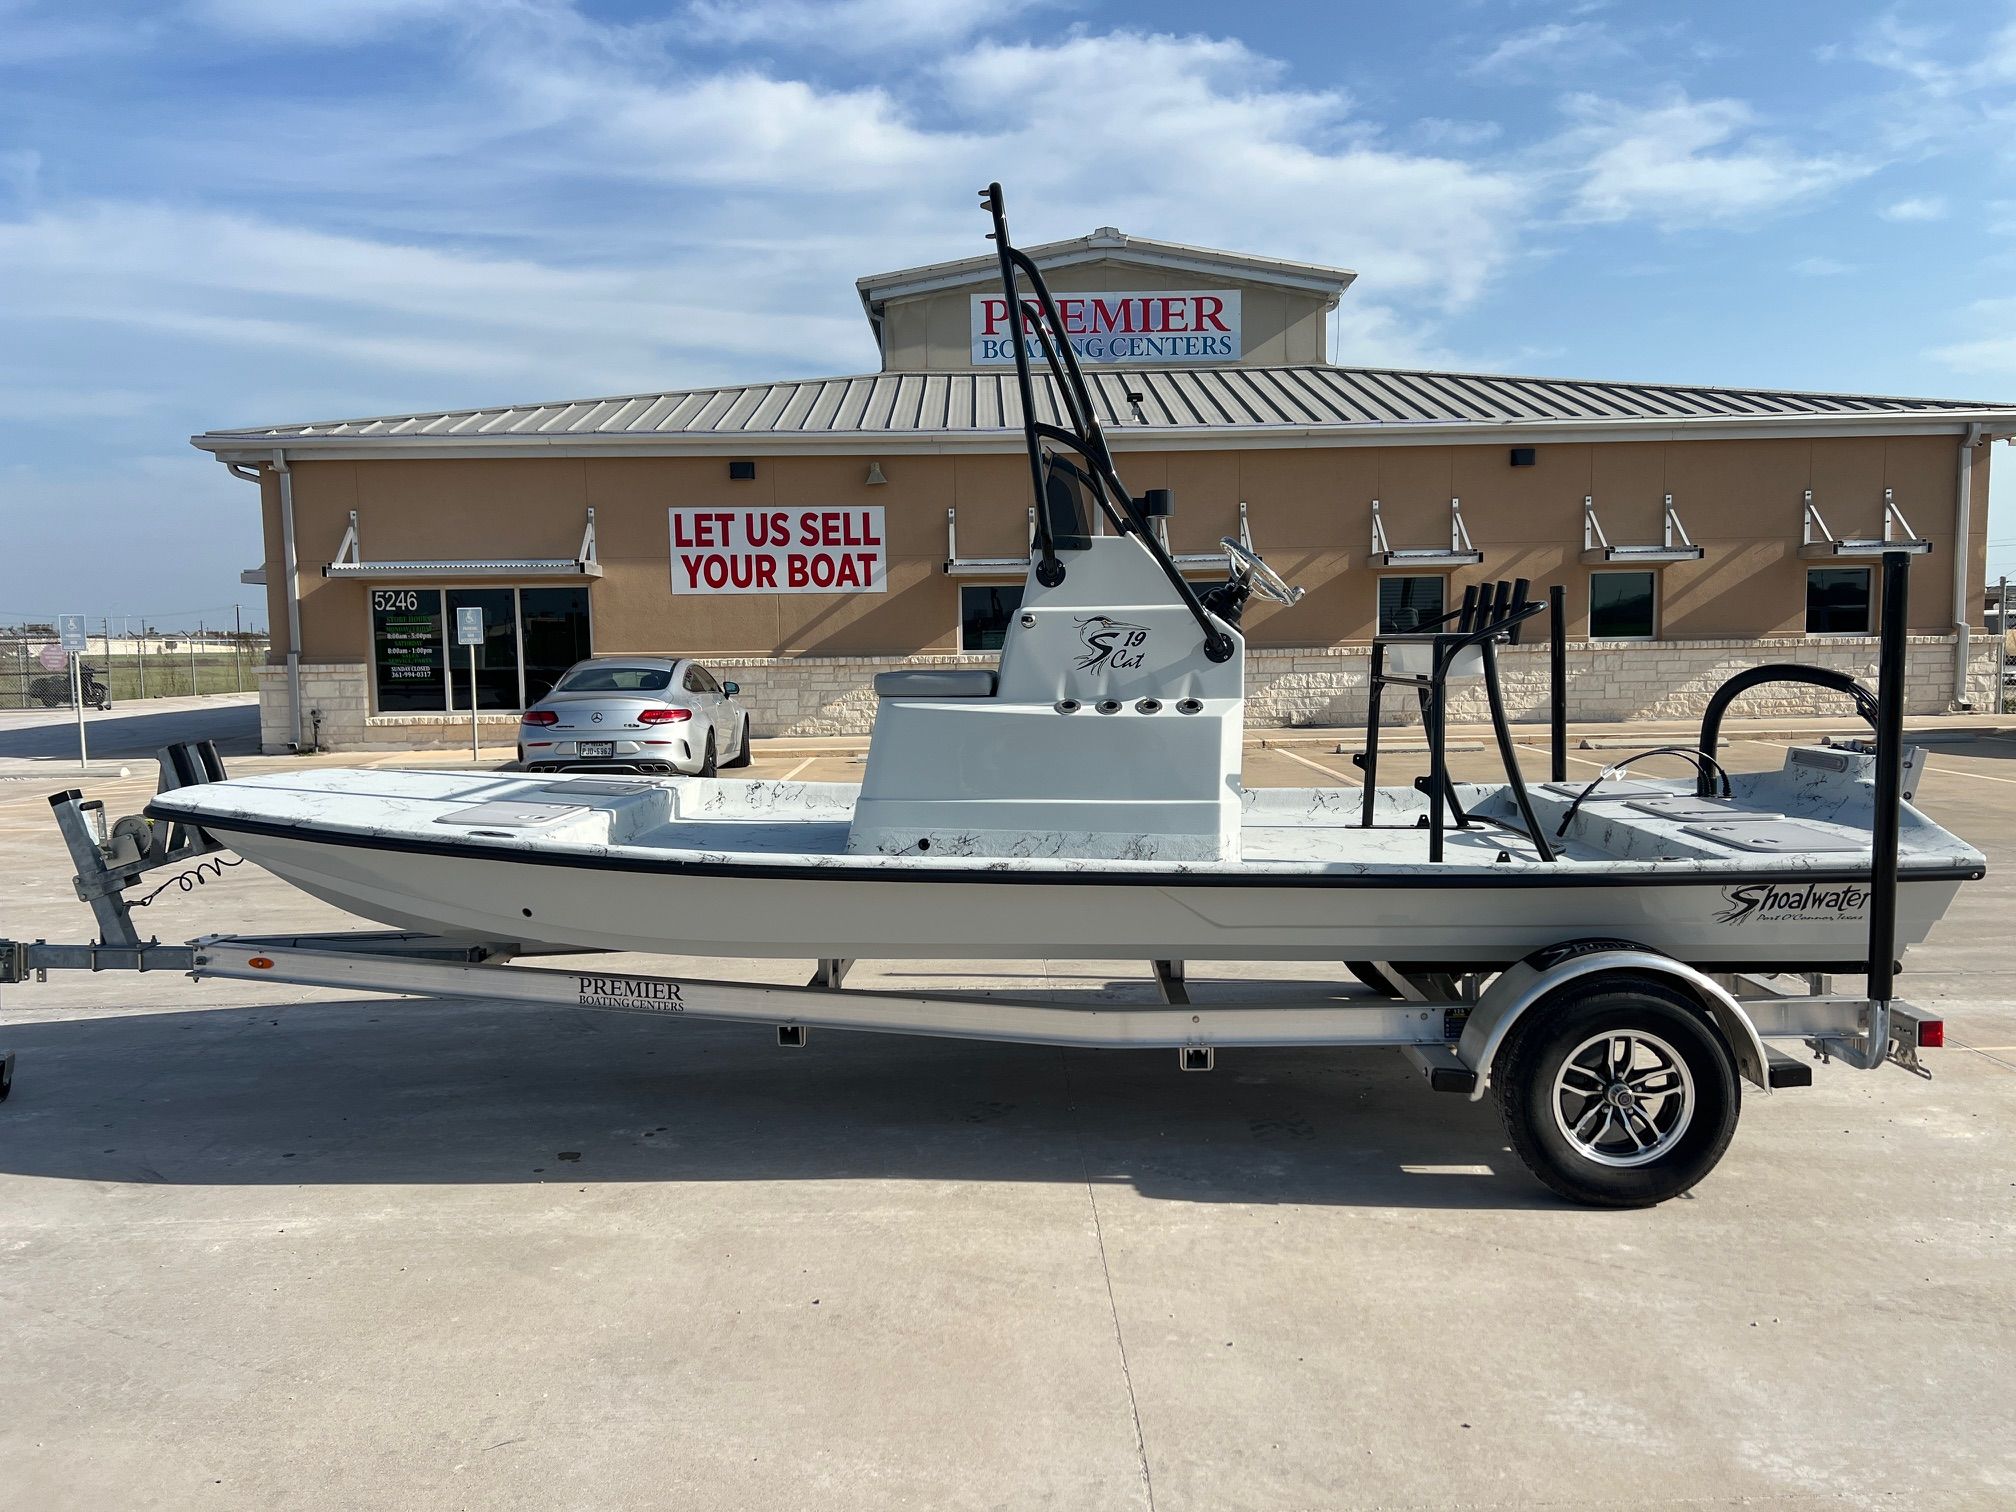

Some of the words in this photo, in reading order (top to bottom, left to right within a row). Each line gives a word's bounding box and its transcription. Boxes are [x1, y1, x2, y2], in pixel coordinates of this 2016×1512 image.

[981, 296, 1231, 335] PREMIER
[1110, 335, 1232, 358] CENTERS
[674, 513, 735, 547] LET
[745, 512, 791, 547] US
[800, 512, 881, 546] SELL
[680, 553, 778, 589] YOUR
[787, 553, 878, 587] BOAT
[374, 591, 418, 611] 5246
[1123, 631, 1147, 647] 19
[1110, 649, 1146, 668] Cat
[1717, 883, 1872, 924] Shoalwater
[579, 977, 684, 1002] PREMIER
[579, 995, 630, 1008] BOATING
[631, 999, 684, 1012] CENTERS
